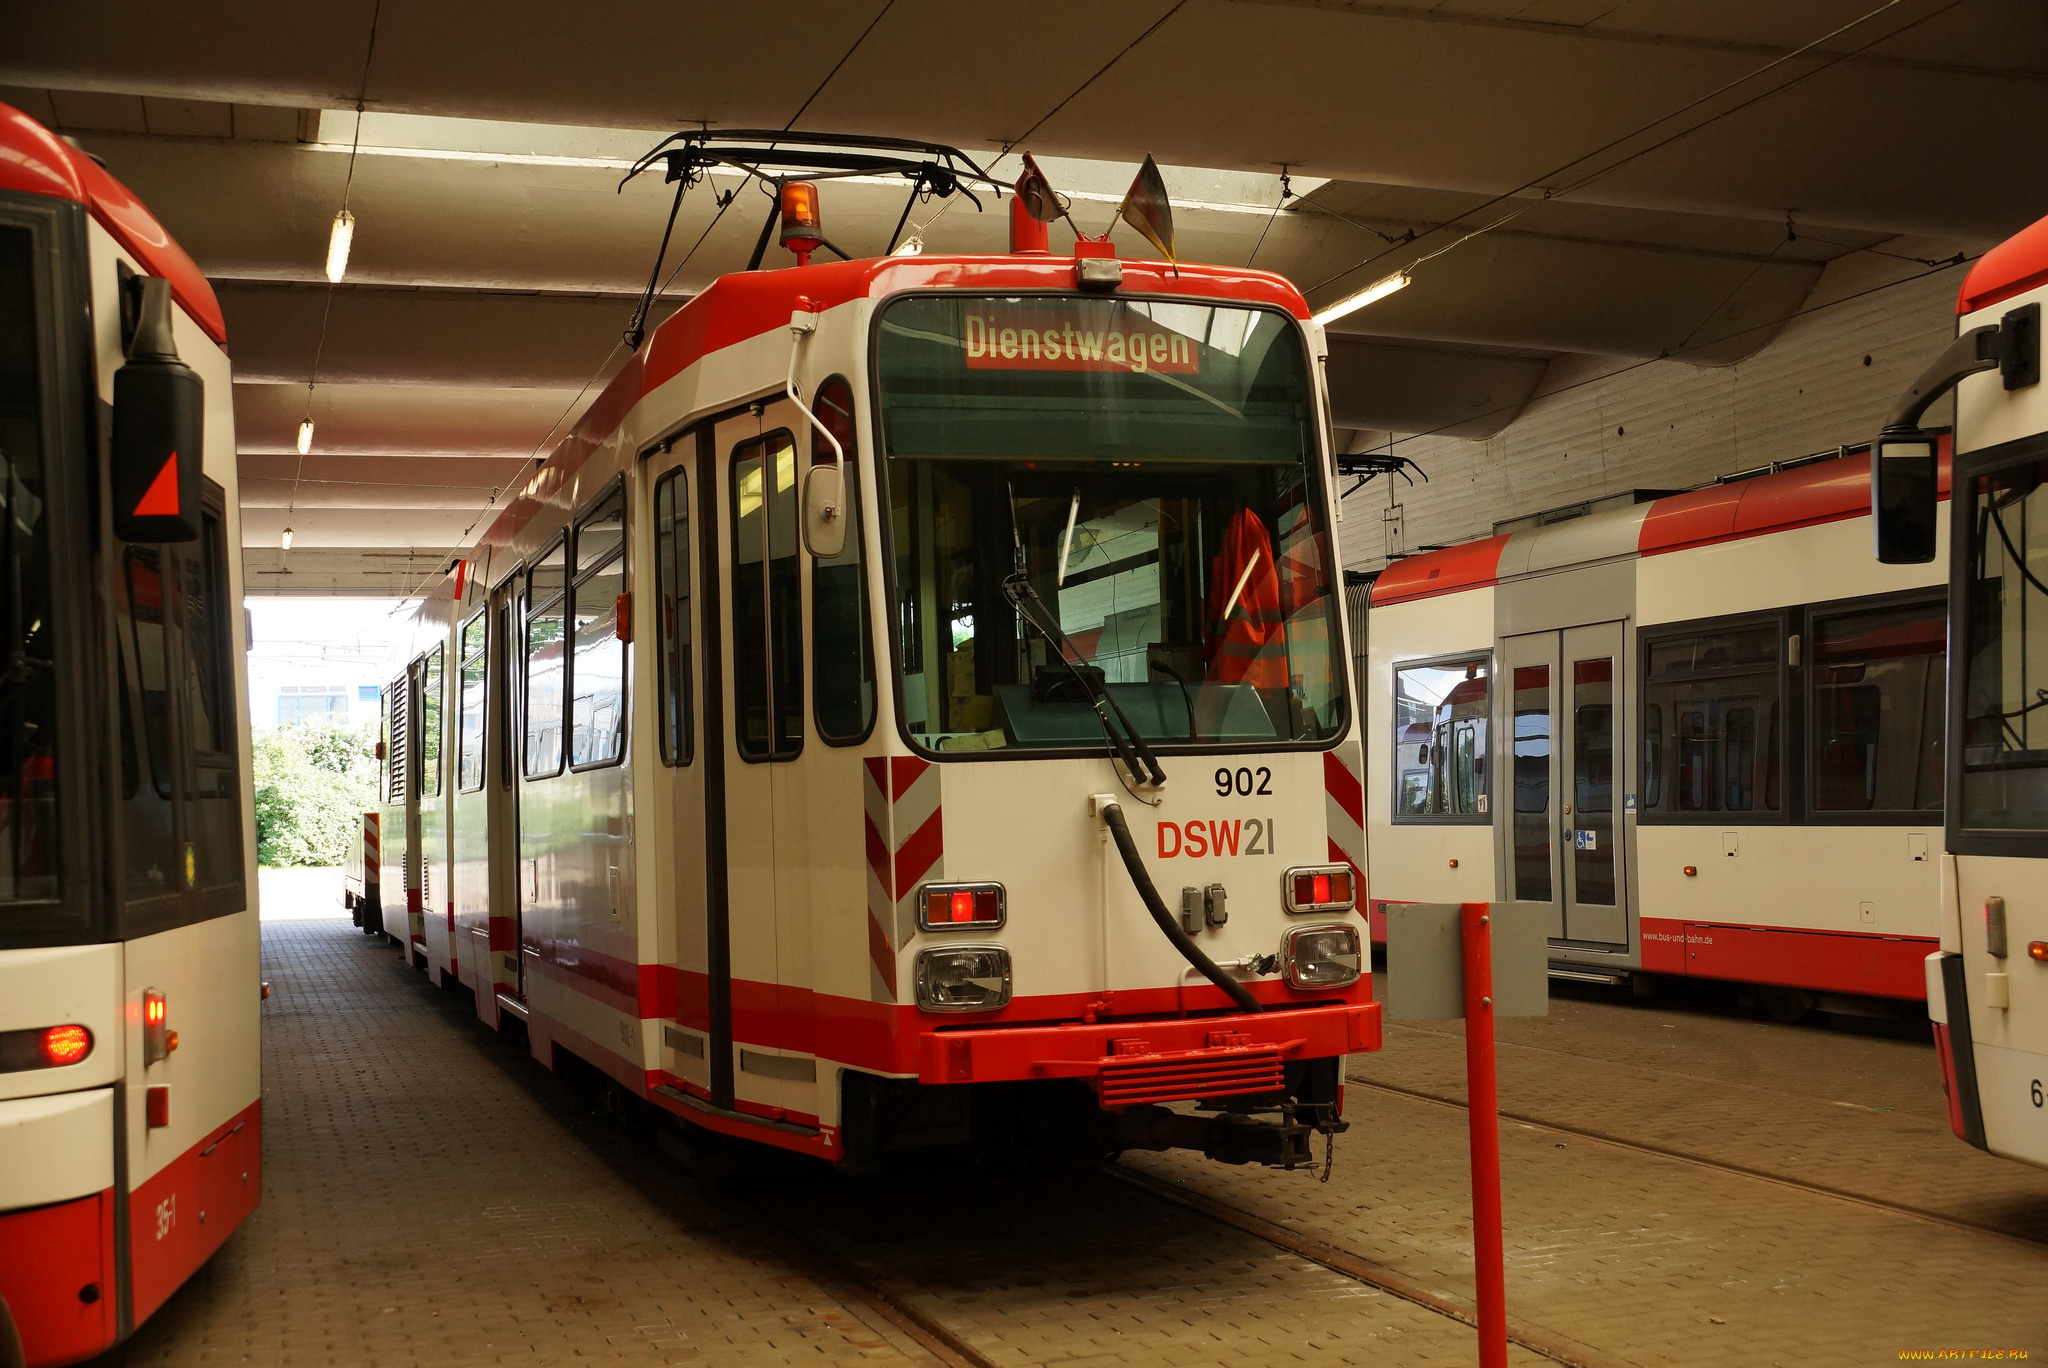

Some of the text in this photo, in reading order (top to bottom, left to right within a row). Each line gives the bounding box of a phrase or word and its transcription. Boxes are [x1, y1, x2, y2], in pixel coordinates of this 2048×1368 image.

[966, 315, 1190, 373] Dienstwagen
[1214, 766, 1273, 797] 902
[1157, 818, 1275, 859] DSW21
[1642, 932, 1713, 945] www.bus-und-bahn.de
[156, 1192, 176, 1240] 35-1
